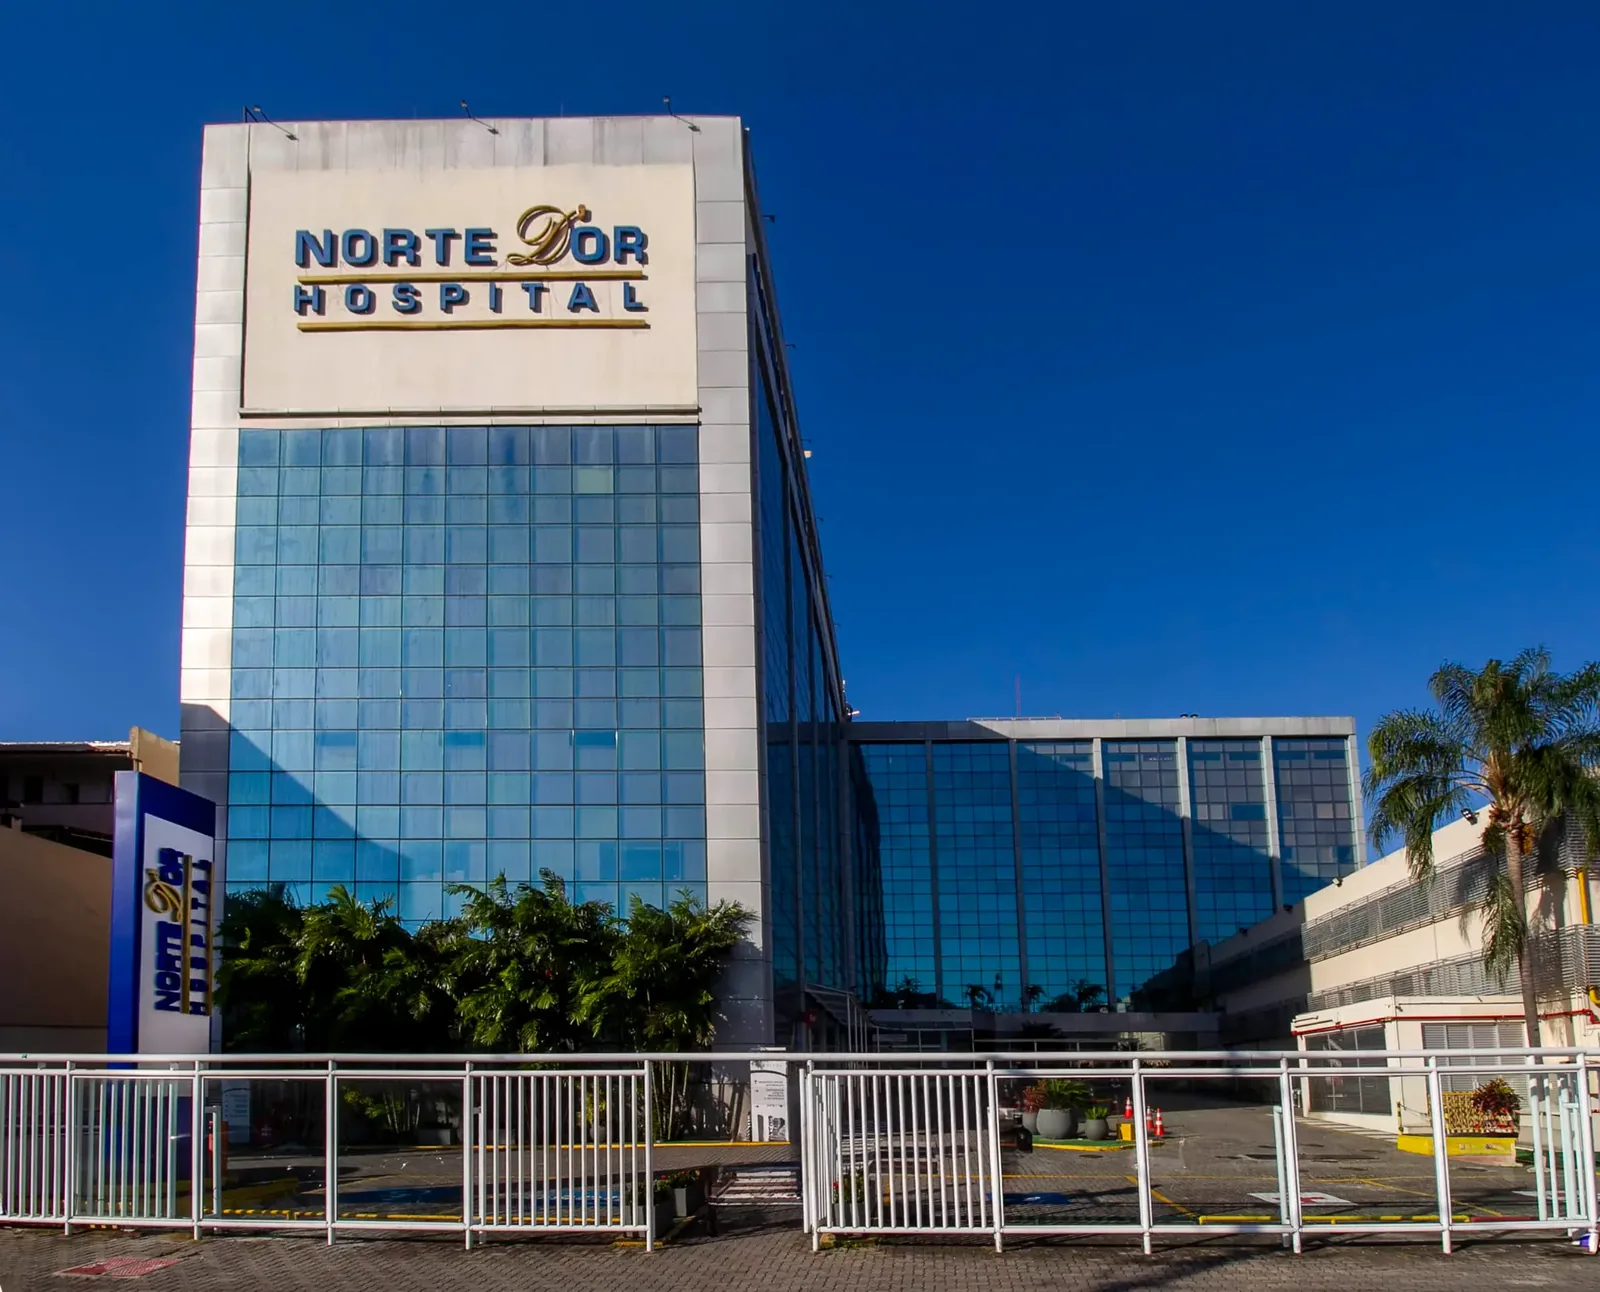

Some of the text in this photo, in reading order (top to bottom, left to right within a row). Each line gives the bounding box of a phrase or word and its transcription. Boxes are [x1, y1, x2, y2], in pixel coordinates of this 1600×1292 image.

[294, 227, 497, 267] NORTE
[294, 281, 649, 315] HOSPITAL
[154, 921, 183, 1013] NORTE
